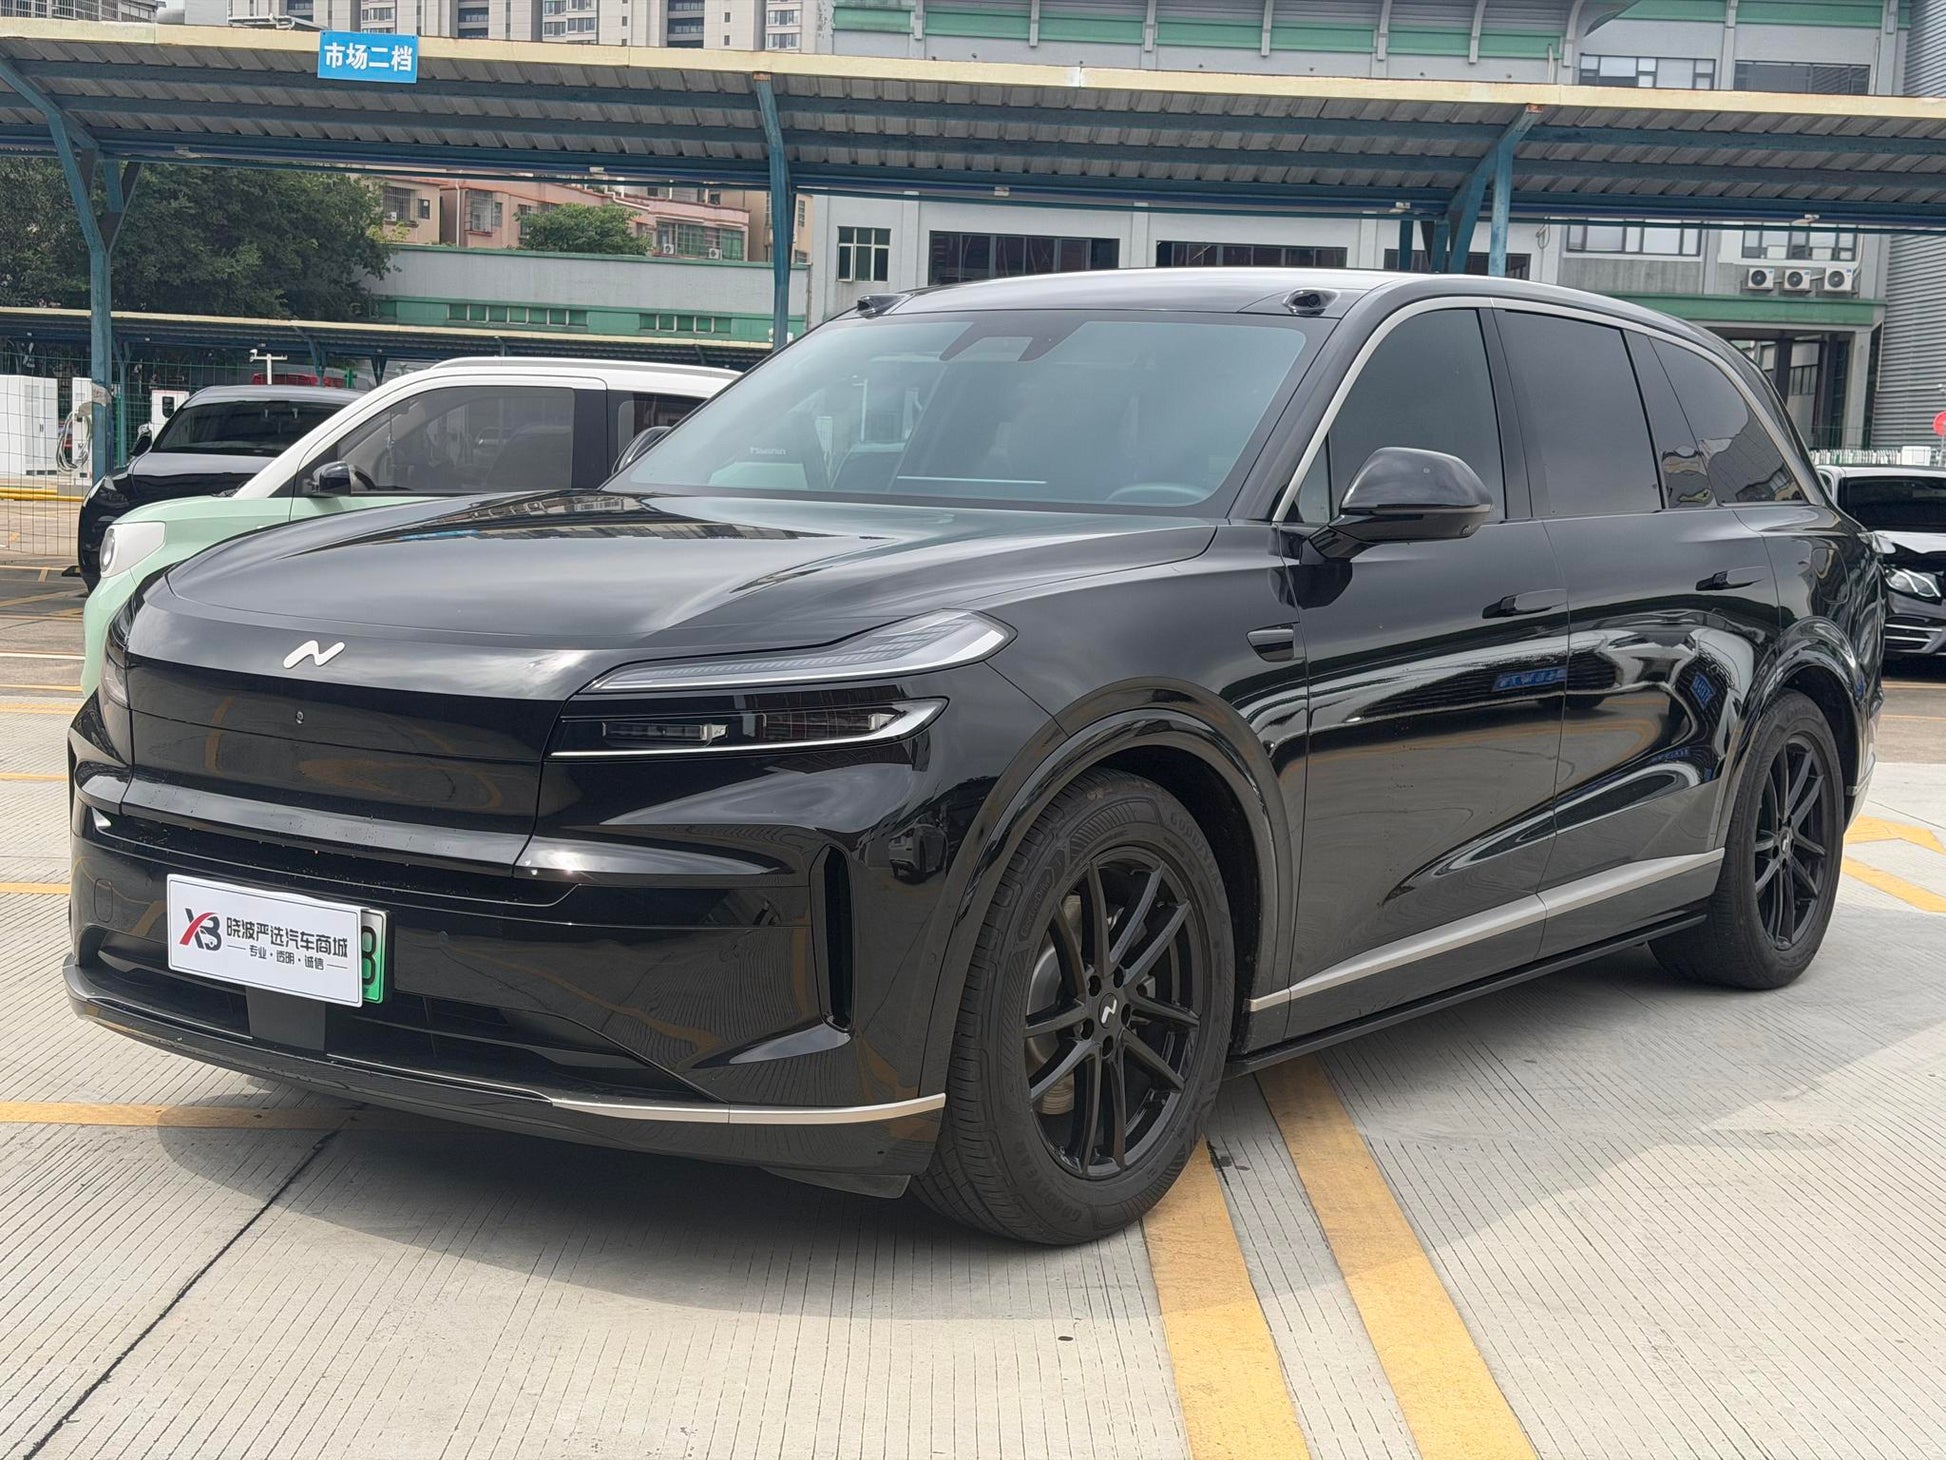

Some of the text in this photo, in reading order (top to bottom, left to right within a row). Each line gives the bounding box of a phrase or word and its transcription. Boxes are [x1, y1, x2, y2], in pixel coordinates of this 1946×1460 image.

[324, 42, 413, 72] 市场二档
[226, 917, 348, 958] 晓波严选汽车商城
